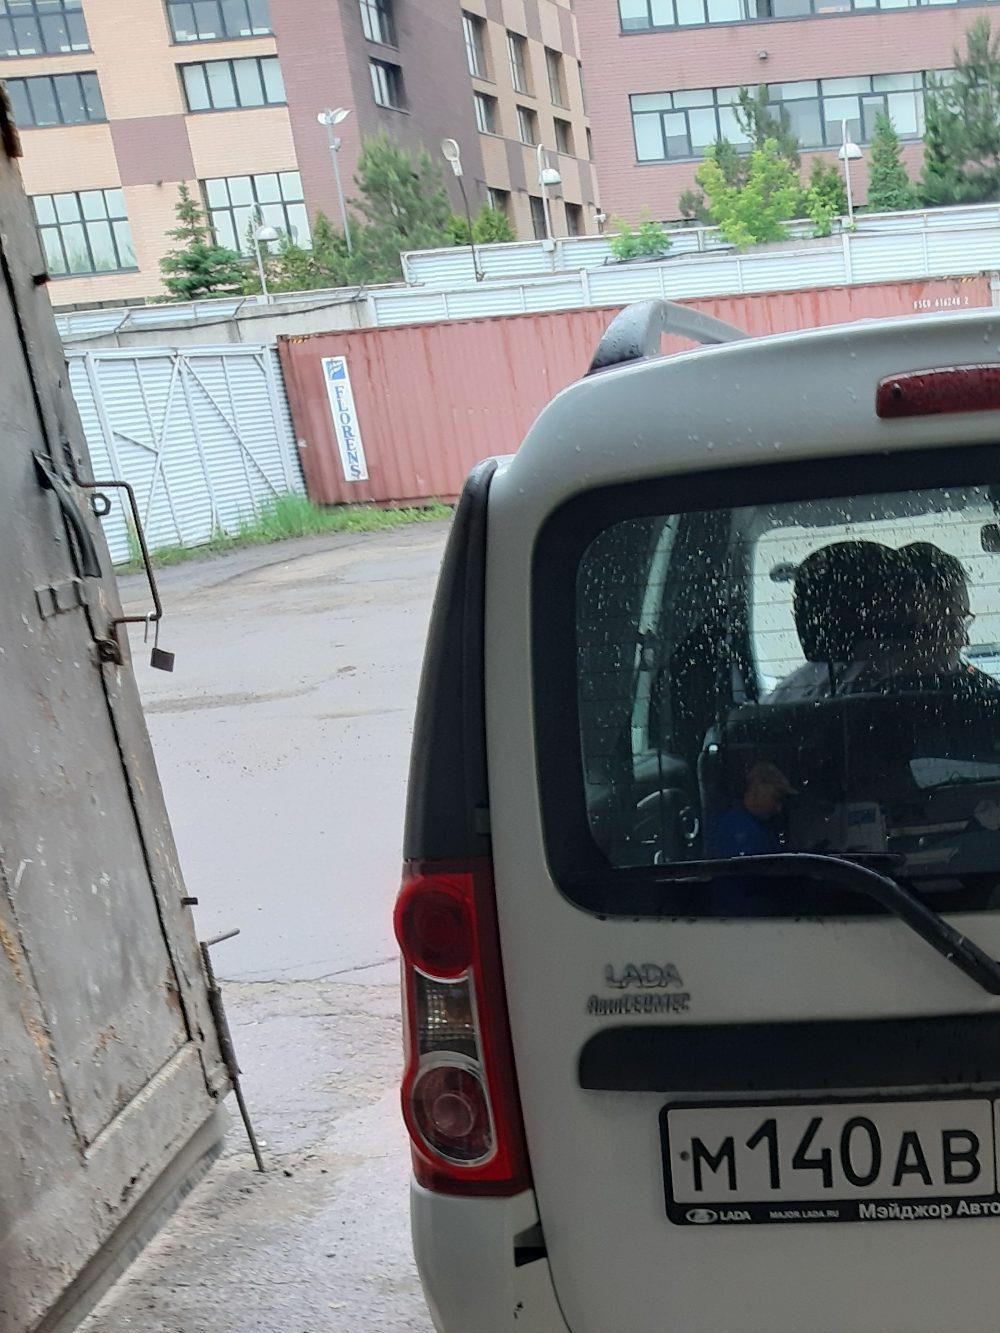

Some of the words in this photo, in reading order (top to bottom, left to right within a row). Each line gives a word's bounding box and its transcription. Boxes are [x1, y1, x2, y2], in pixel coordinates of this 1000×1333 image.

[334, 385, 361, 478] FLORENS
[605, 963, 684, 989] LADA
[690, 1116, 981, 1191] М140АВ
[719, 1210, 751, 1221] LADA
[858, 1202, 951, 1219] Мэйджор
